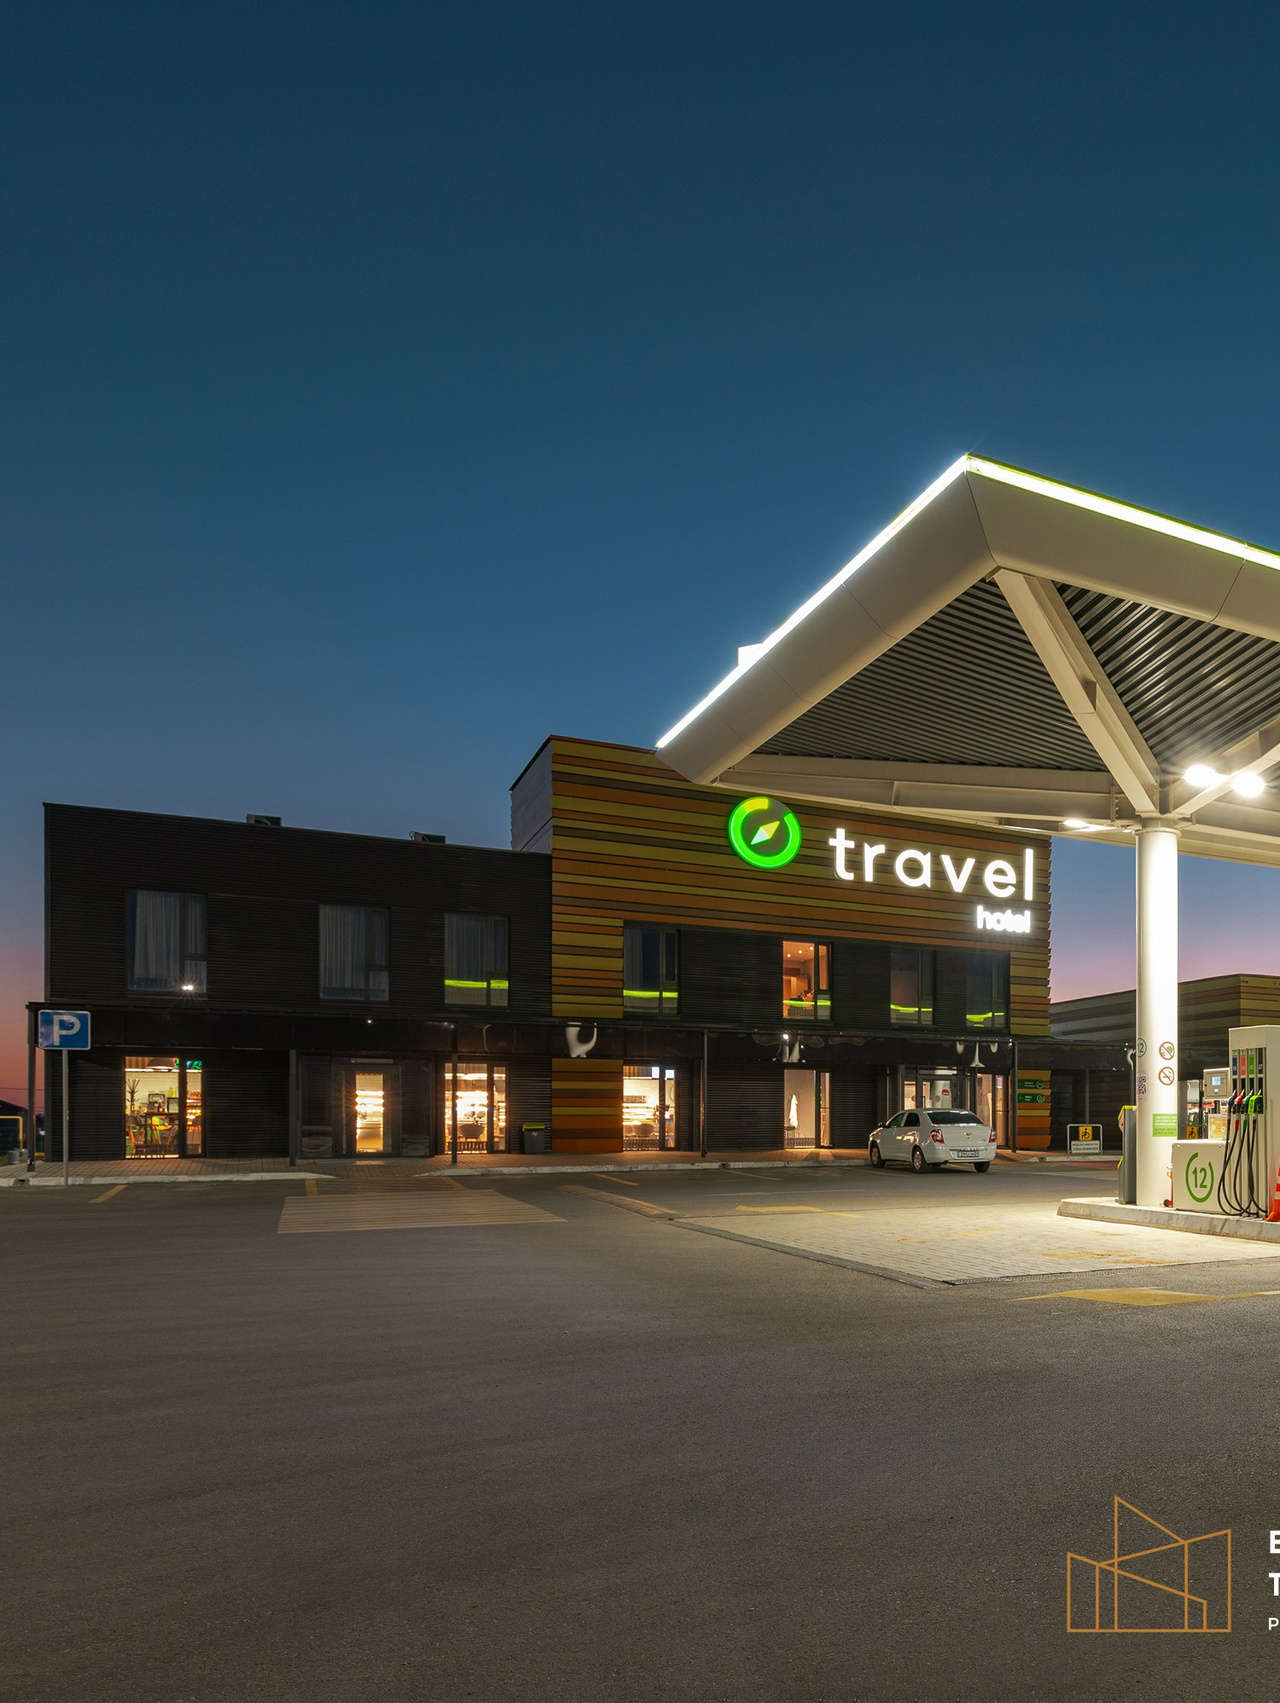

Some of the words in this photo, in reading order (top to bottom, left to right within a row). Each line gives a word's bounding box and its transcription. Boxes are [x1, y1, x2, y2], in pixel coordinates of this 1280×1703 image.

[828, 827, 1034, 901] travel
[976, 905, 1031, 933] hotel
[53, 1015, 81, 1046] P
[1192, 1166, 1208, 1189] 12
